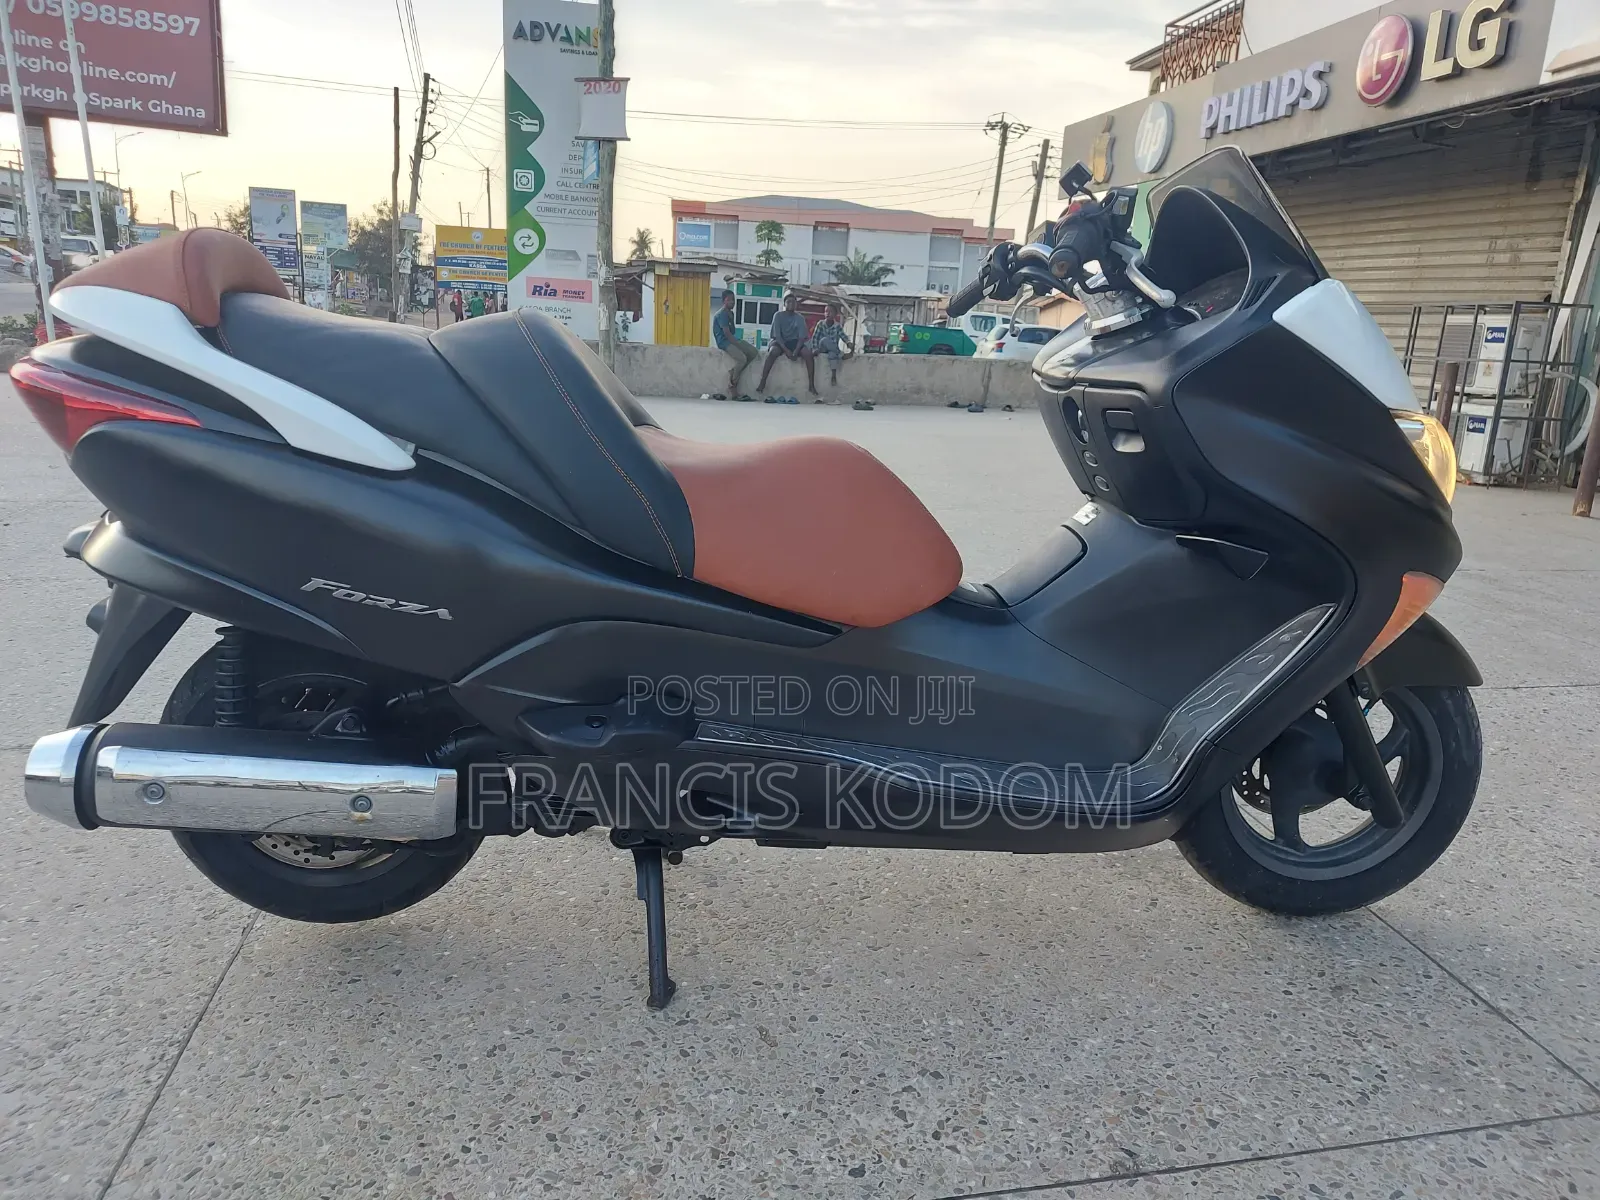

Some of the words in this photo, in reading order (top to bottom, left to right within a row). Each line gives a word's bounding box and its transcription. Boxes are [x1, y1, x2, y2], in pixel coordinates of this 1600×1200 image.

[11, 29, 53, 49] line
[1420, 0, 1509, 81] LG
[560, 48, 581, 56] SAVINGS
[583, 81, 621, 95] 2020
[89, 92, 143, 111] Spark
[148, 99, 206, 119] Ghana
[1200, 61, 1331, 139] PHILIPS
[571, 140, 585, 148] SAV
[1138, 102, 1165, 173] hp
[561, 167, 584, 175] INSUR
[556, 180, 573, 188] CALL
[544, 193, 569, 201] MOBILE
[536, 206, 567, 215] CURRENT
[531, 281, 558, 298] Ria
[544, 306, 572, 314] BRANCH
[300, 577, 454, 621] FORZA
